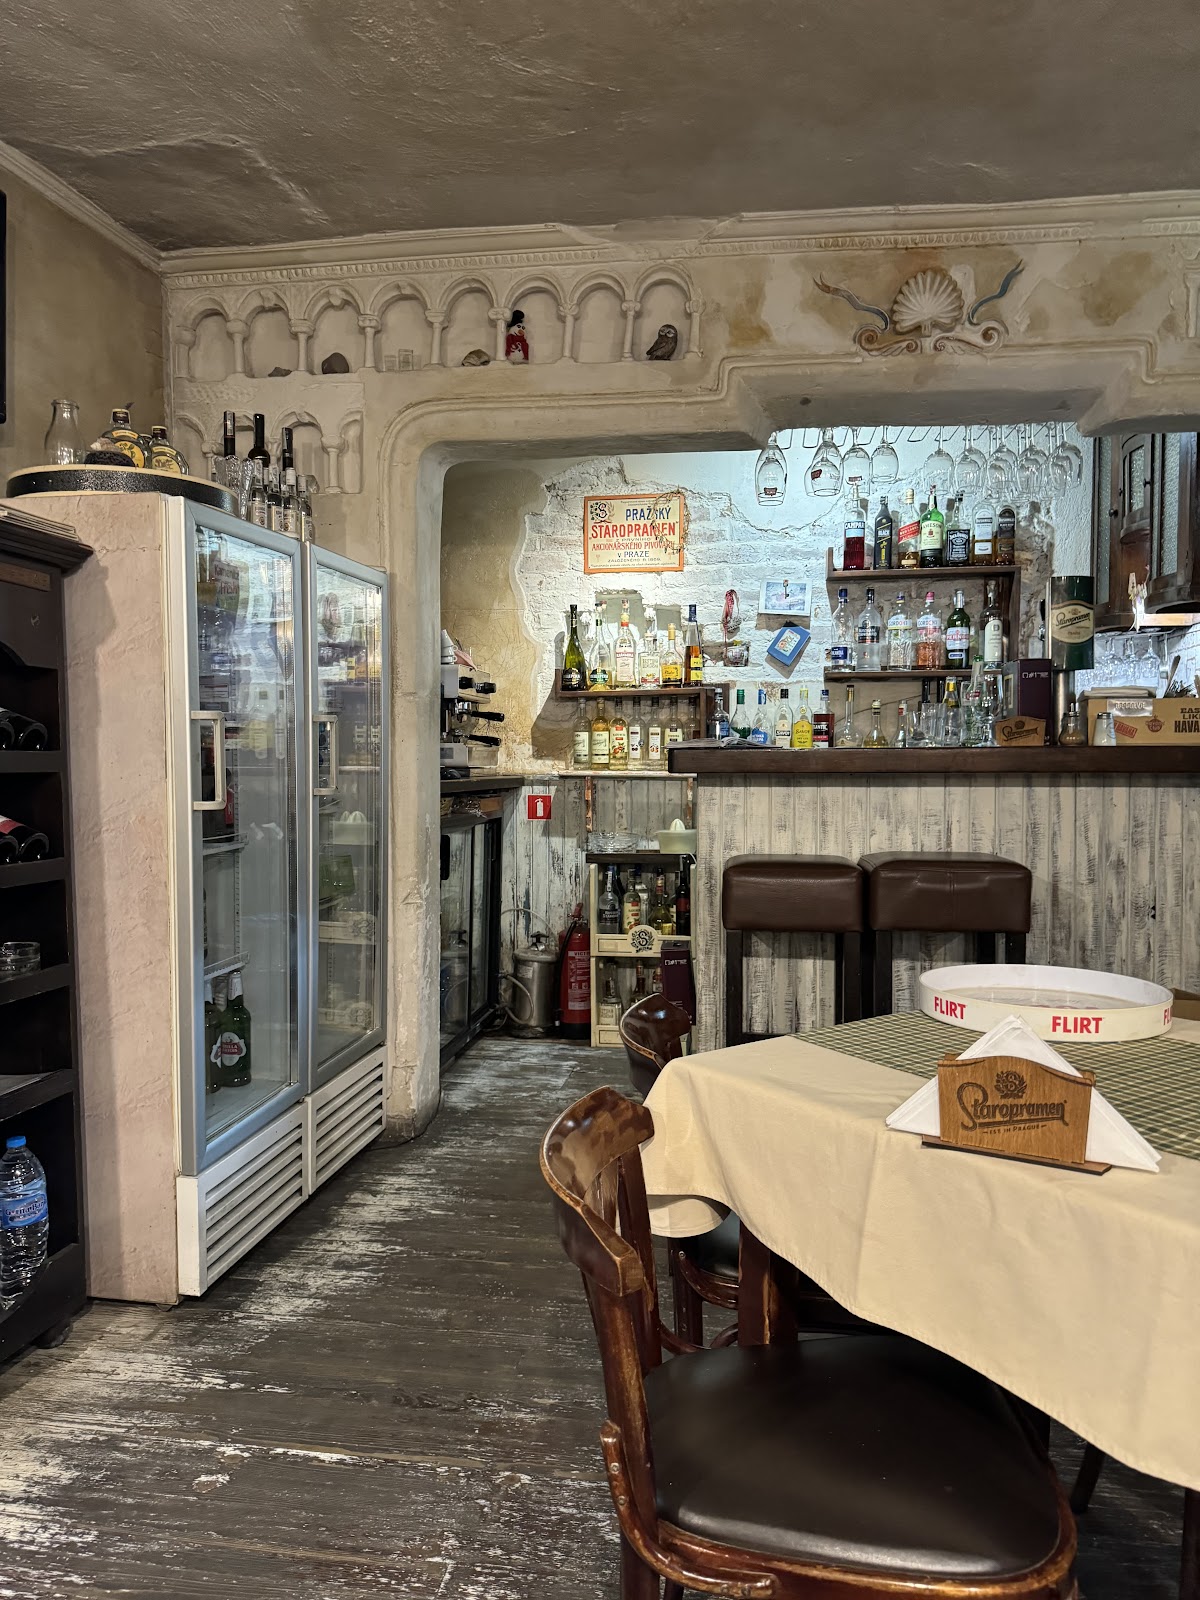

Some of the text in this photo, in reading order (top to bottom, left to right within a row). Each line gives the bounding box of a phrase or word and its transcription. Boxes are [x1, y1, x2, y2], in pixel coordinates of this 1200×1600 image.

[623, 550, 650, 558] PRAZE
[934, 996, 966, 1020] FLIRT
[1051, 1016, 1103, 1034] FLIRT
[957, 1082, 1069, 1132] Staropramen
[1013, 1124, 1040, 1132] PRAGUE
